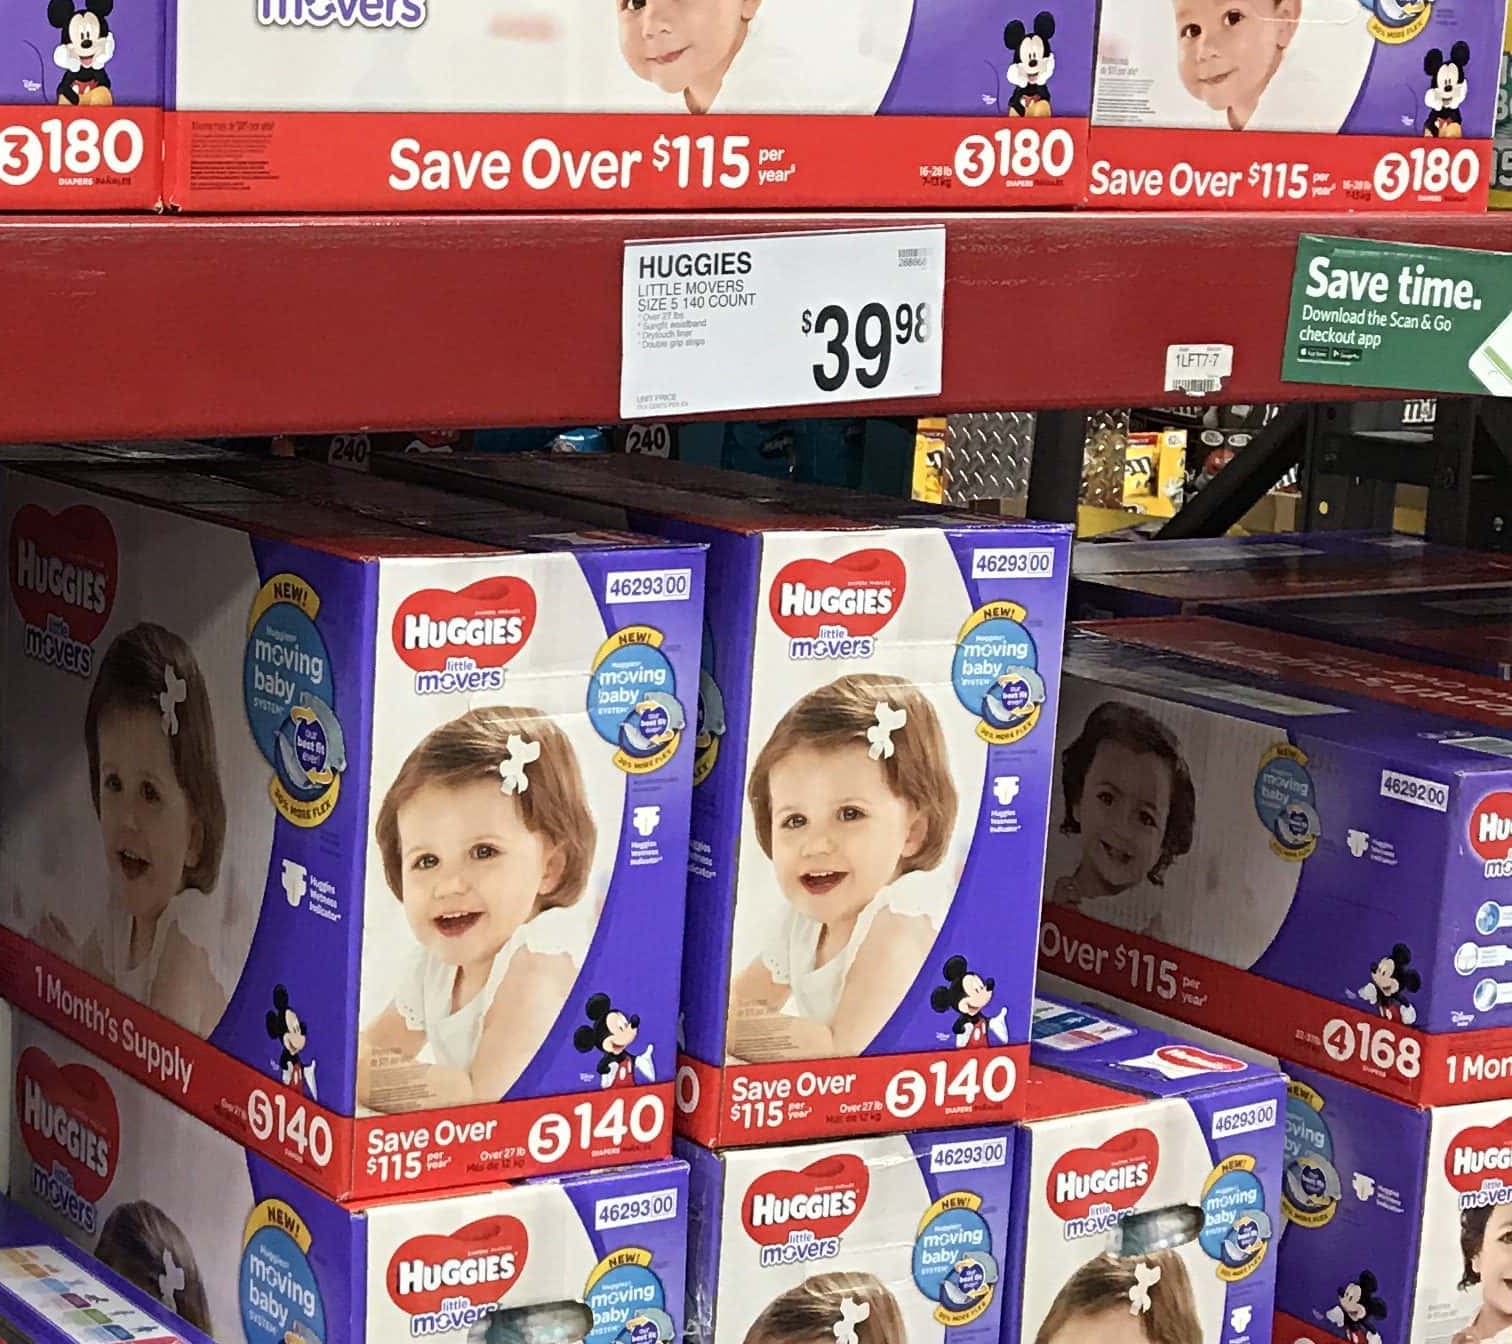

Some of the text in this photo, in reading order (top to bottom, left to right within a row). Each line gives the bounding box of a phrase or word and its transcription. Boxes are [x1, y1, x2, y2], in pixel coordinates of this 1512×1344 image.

[40, 117, 144, 174] 180
[387, 133, 752, 193] Save Over $115
[994, 127, 1074, 178] 180
[1090, 160, 1309, 200] Save Over $115
[1408, 146, 1480, 194] 180
[638, 250, 753, 280] HUGGIES
[1304, 255, 1483, 311] Save time.
[637, 279, 745, 299] LITTLE MOVERS
[637, 293, 757, 313] SIZE 5 140 COUNT
[1298, 324, 1383, 349] checkout app
[1301, 304, 1453, 333] Download the Scan & Go
[779, 582, 895, 618] HUGGIES
[403, 612, 524, 650] HUGGIES
[961, 640, 1029, 664] moving
[46, 971, 120, 1042] Month's
[121, 1019, 196, 1091] Supply
[1354, 1020, 1422, 1076] 168
[929, 1056, 1017, 1105] 140
[576, 1094, 665, 1146] 140
[751, 1187, 859, 1229] HUGGIES
